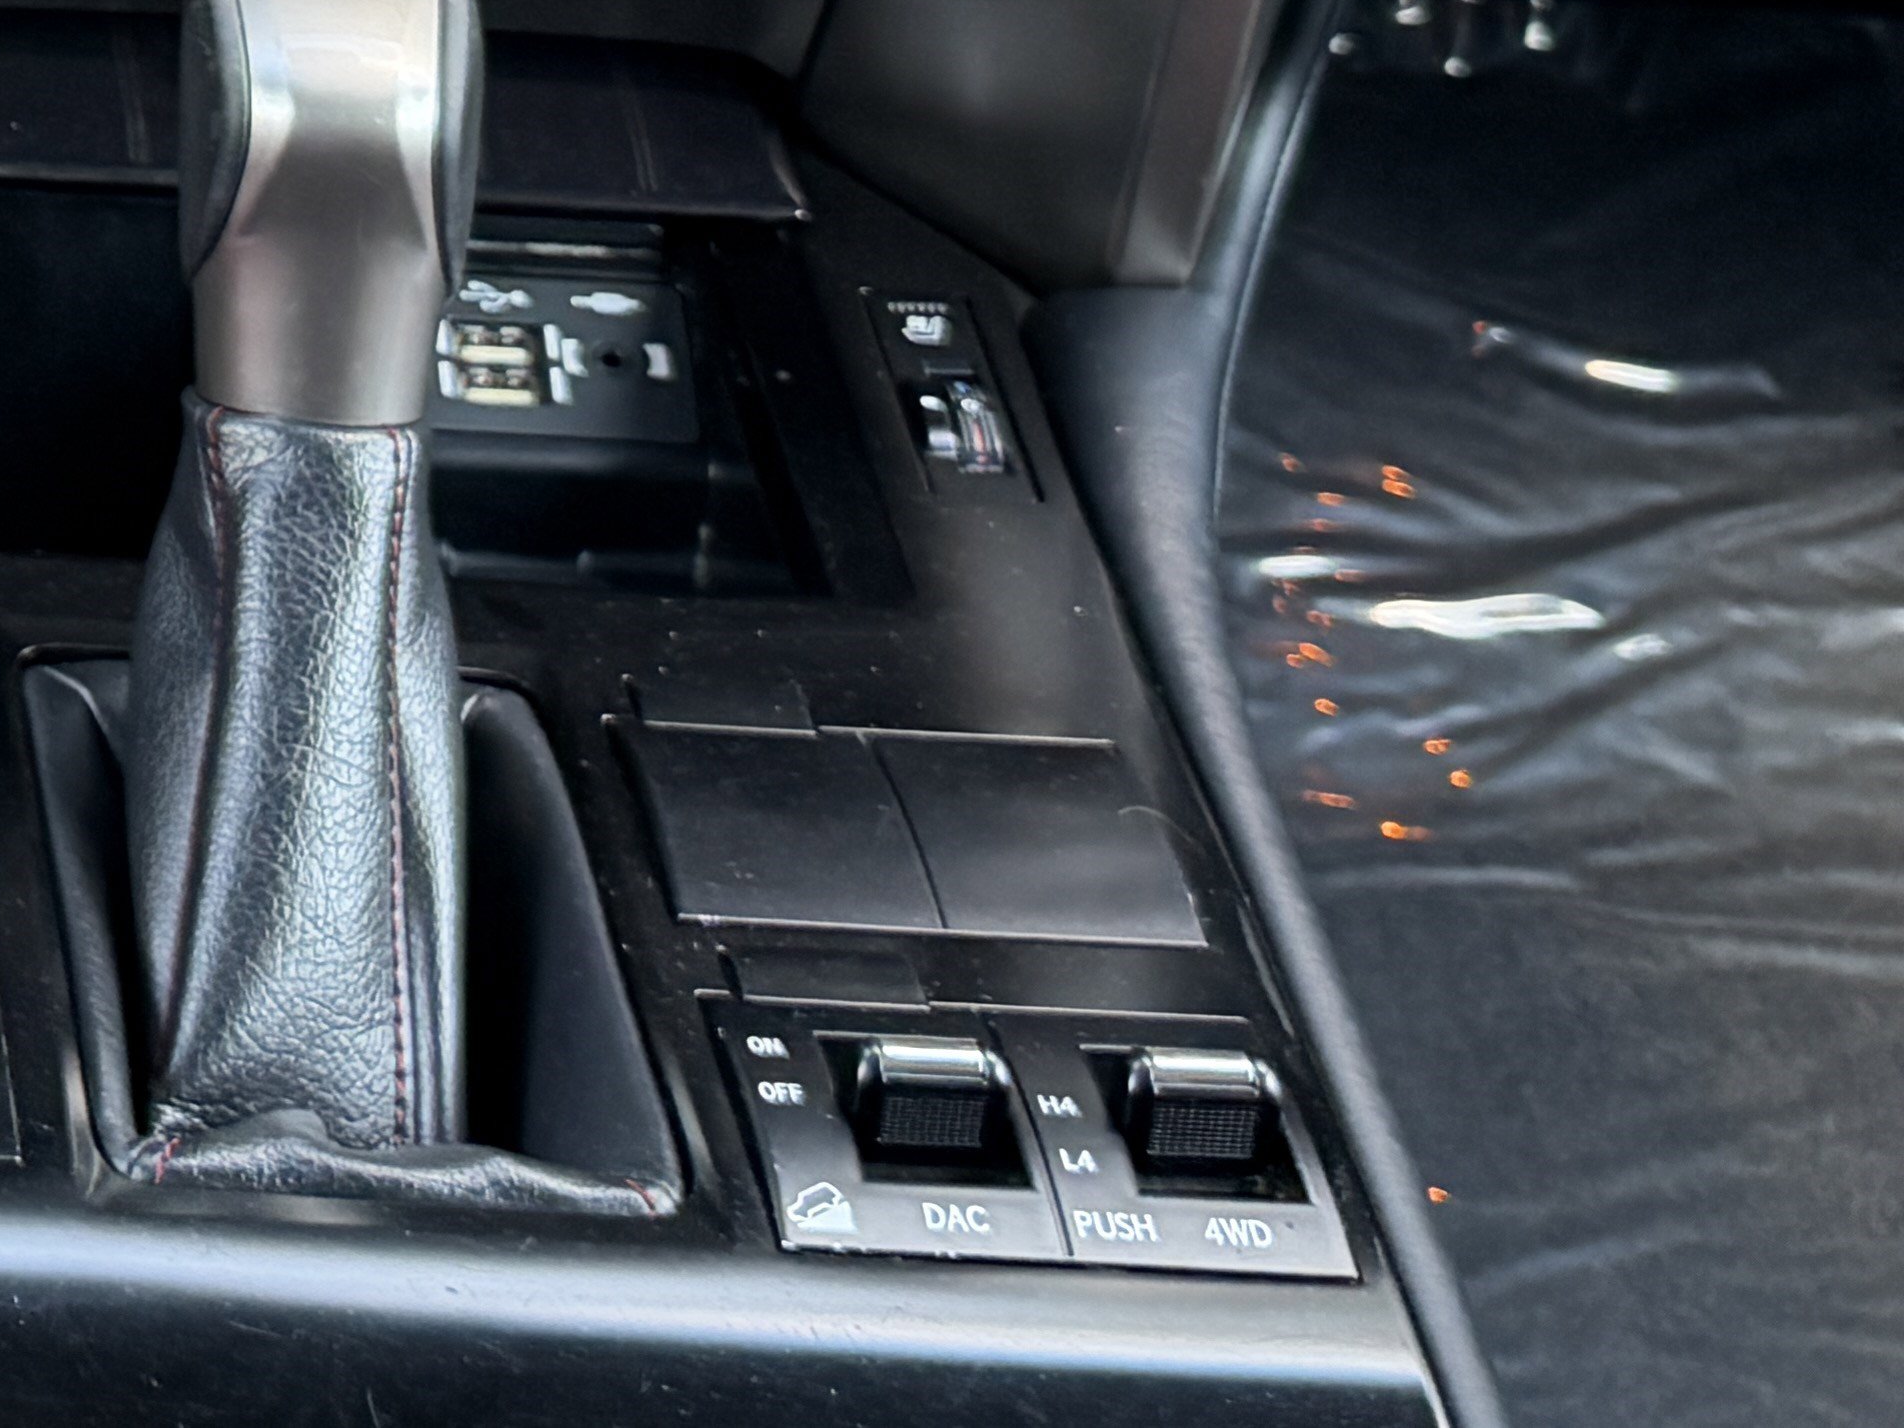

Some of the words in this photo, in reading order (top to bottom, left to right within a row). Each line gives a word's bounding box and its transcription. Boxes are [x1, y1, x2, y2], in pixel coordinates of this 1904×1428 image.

[745, 1034, 789, 1059] ON
[757, 1081, 805, 1106] OFF
[1038, 1094, 1081, 1119] H4
[1059, 1148, 1097, 1175] L4
[921, 1203, 992, 1234] DAC
[1074, 1211, 1158, 1243] PUSH
[1203, 1218, 1275, 1249] 4WD
